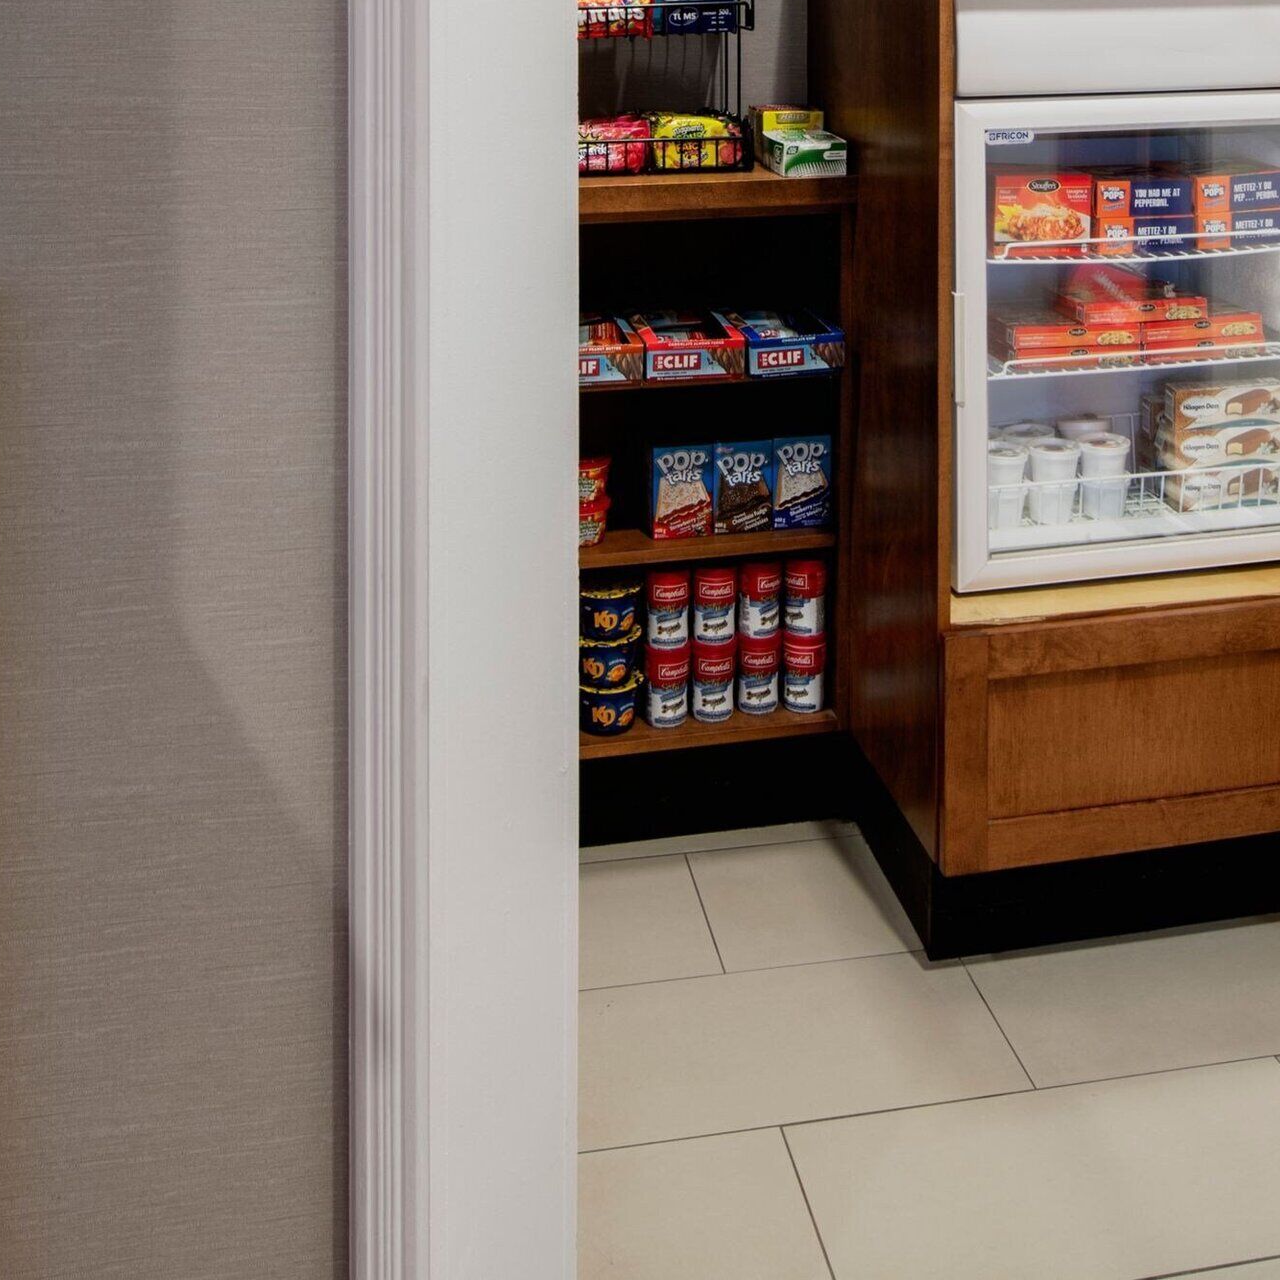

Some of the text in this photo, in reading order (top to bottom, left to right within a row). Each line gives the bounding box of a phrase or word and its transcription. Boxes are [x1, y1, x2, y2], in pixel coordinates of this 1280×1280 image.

[1103, 190, 1125, 200] POPS
[1134, 188, 1181, 198] YOU HAD ME AT
[1203, 187, 1224, 197] POPS
[1205, 223, 1226, 233] POPS
[663, 354, 699, 369] CLIF
[767, 351, 802, 367] CLIF
[655, 588, 686, 599] Campbell's
[701, 584, 731, 597] Campbell's
[743, 654, 774, 666] Campbell's
[700, 660, 731, 672] Campbell's
